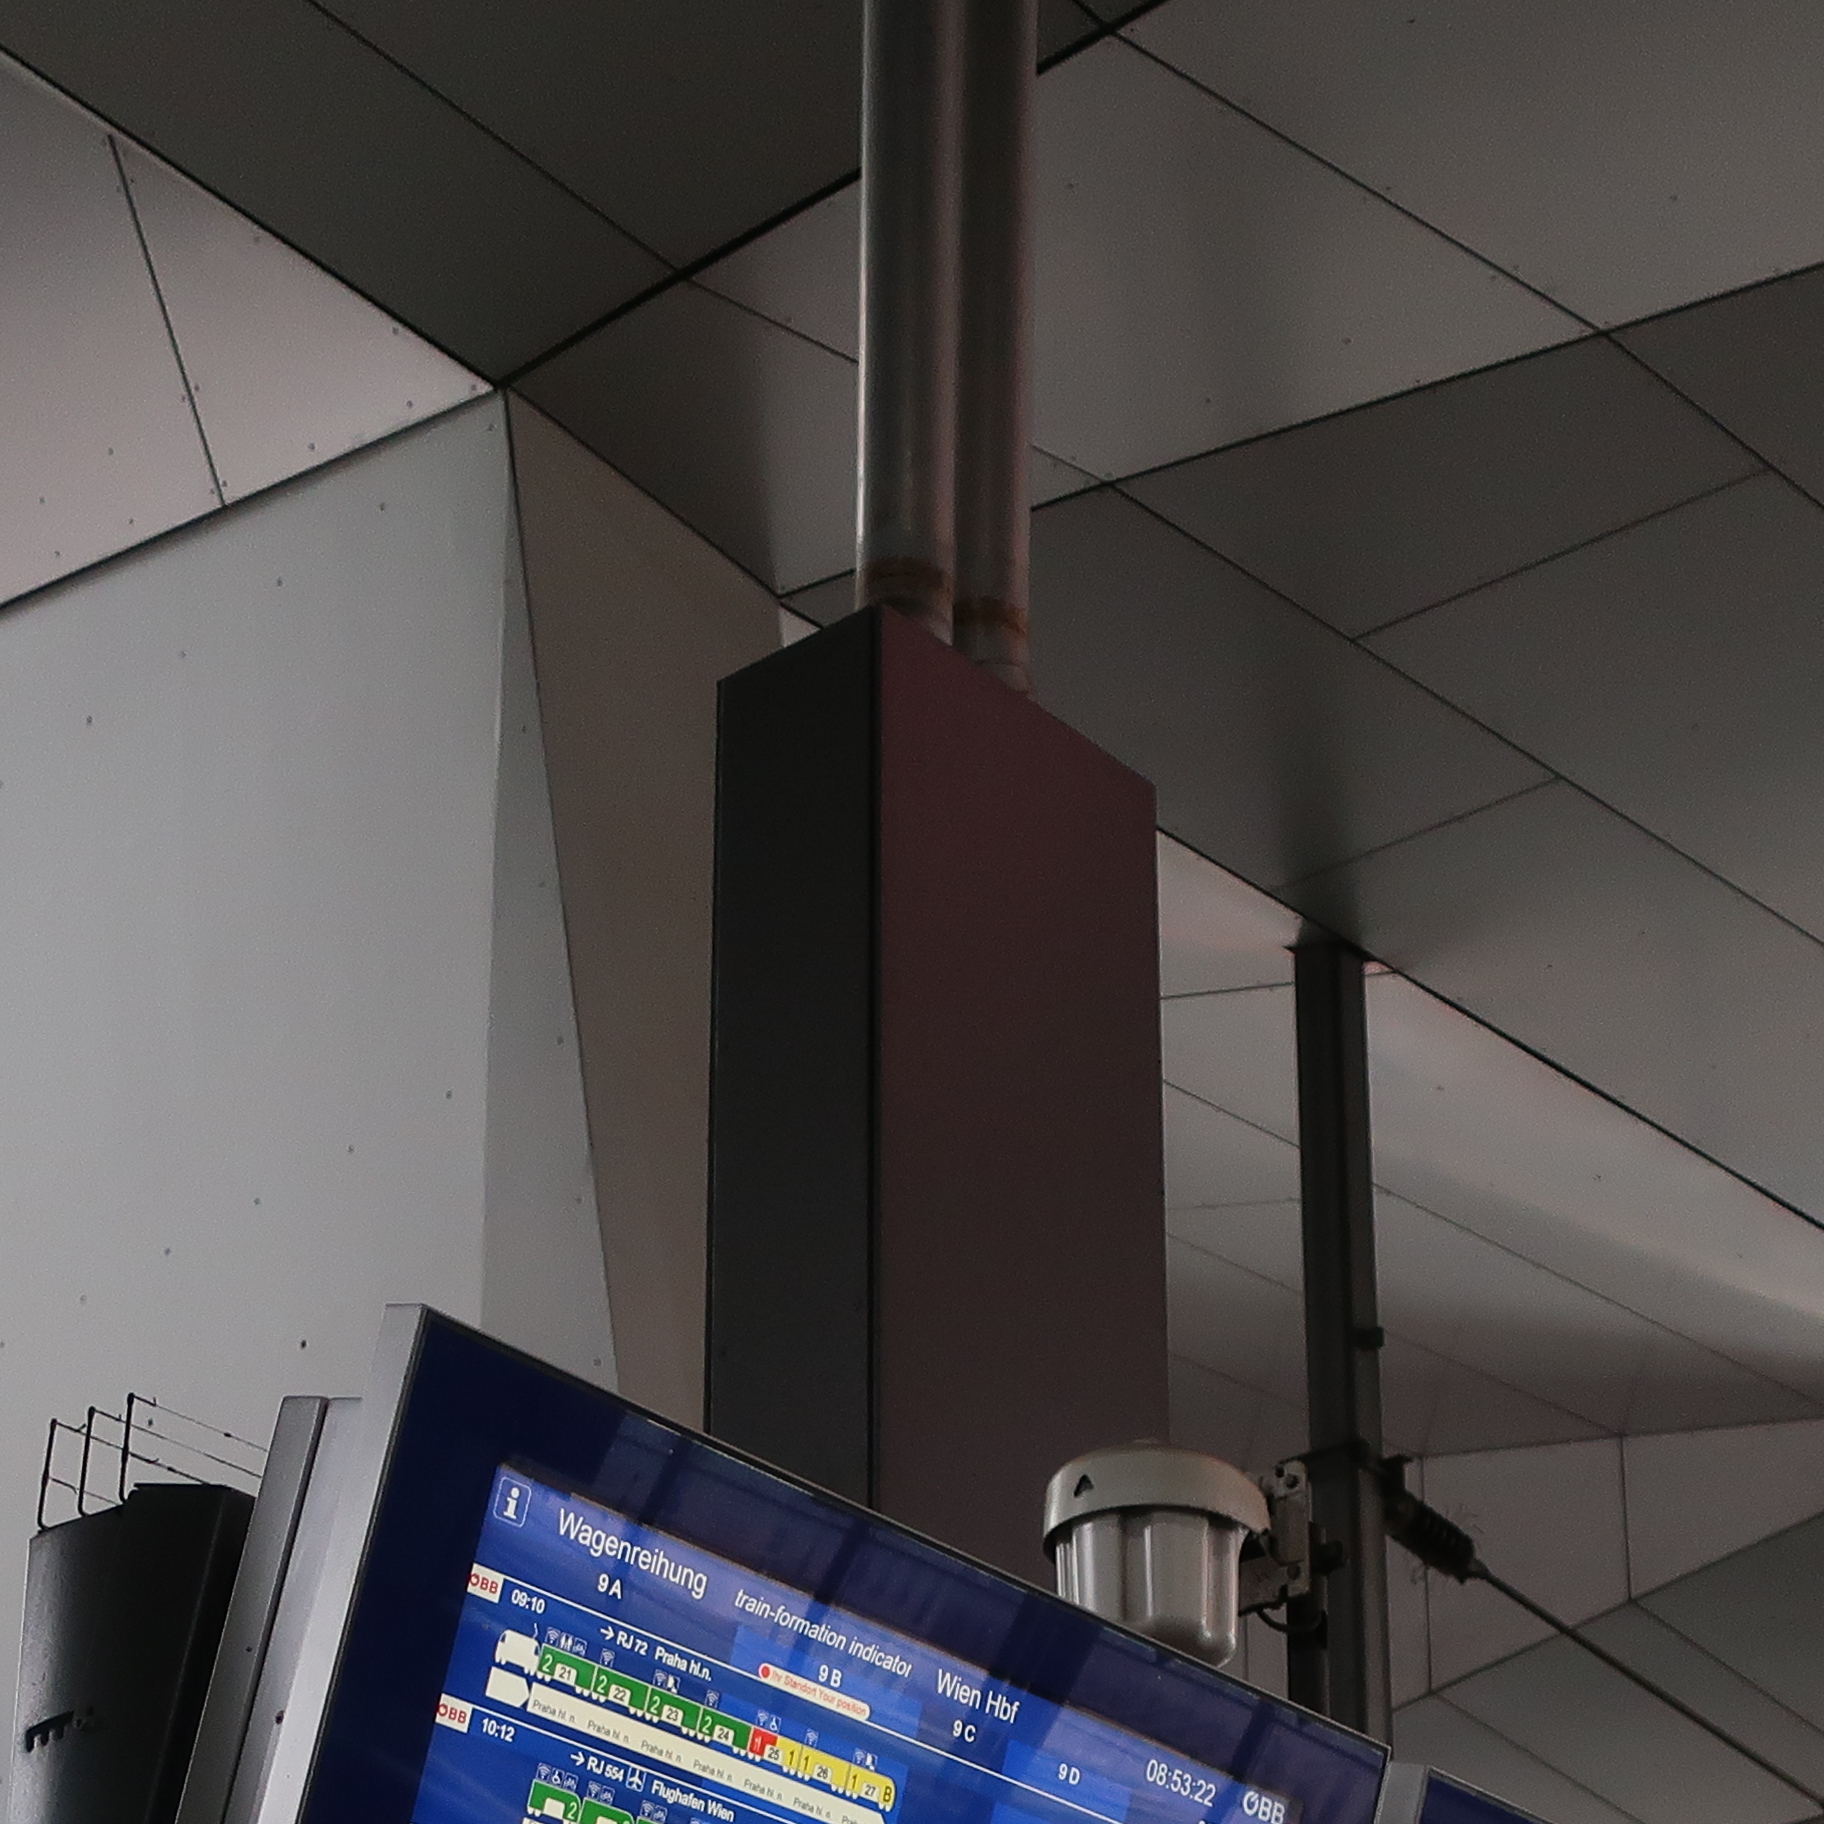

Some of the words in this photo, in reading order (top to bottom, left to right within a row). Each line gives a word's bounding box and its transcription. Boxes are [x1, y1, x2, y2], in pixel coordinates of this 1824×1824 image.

[557, 1508, 708, 1599] Wagenreihung
[511, 1588, 546, 1614] 09:10
[597, 1573, 609, 1592] 9
[608, 1579, 623, 1600] A
[616, 1631, 633, 1653] RJ
[633, 1636, 648, 1657] 72
[654, 1647, 687, 1672] Praha
[734, 1589, 846, 1650] train-formation
[848, 1636, 912, 1678] indicator
[819, 1664, 830, 1682] 9
[830, 1669, 842, 1688] B
[937, 1669, 981, 1710] Wien
[986, 1689, 1021, 1724] Hbf
[558, 1665, 572, 1681] 21
[613, 1686, 627, 1702] 22
[666, 1706, 679, 1722] 23
[716, 1726, 730, 1741] 24
[482, 1718, 516, 1742] 10:12
[952, 1720, 963, 1738] 9
[963, 1725, 976, 1743] C
[587, 1757, 604, 1777] RJ
[604, 1762, 624, 1782] 554
[651, 1779, 706, 1811] Flughafen
[706, 1799, 736, 1823] Wien
[1058, 1764, 1068, 1780] 9
[1069, 1768, 1081, 1785] D
[1146, 1759, 1216, 1807] 08:53:22
